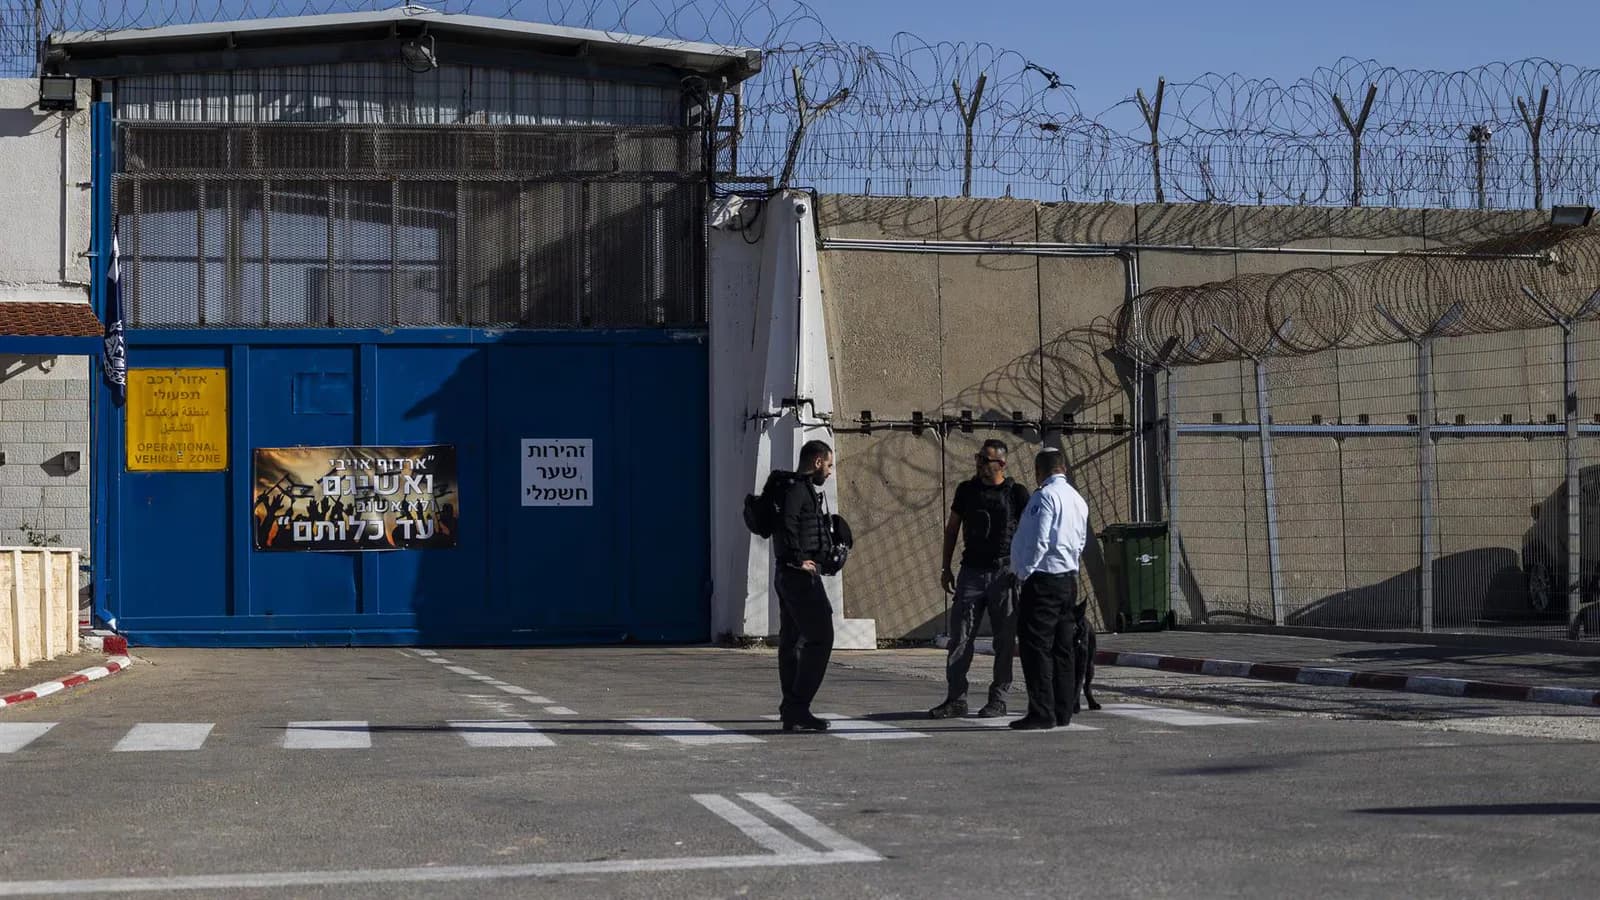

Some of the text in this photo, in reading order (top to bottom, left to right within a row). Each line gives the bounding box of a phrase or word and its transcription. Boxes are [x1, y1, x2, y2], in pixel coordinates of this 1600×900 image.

[147, 375, 207, 385] אזור רכב
[154, 389, 201, 400] תפעולי
[137, 443, 219, 452] OPERATIONAL
[528, 445, 586, 458] זהירות
[135, 454, 221, 464] VEHICLE ZONE
[328, 458, 371, 471] אויבי
[536, 465, 577, 480] שער
[322, 474, 433, 496] ואשיגם
[526, 484, 588, 500] חשמלי
[356, 500, 401, 513] אשוב
[396, 518, 434, 540] עד
